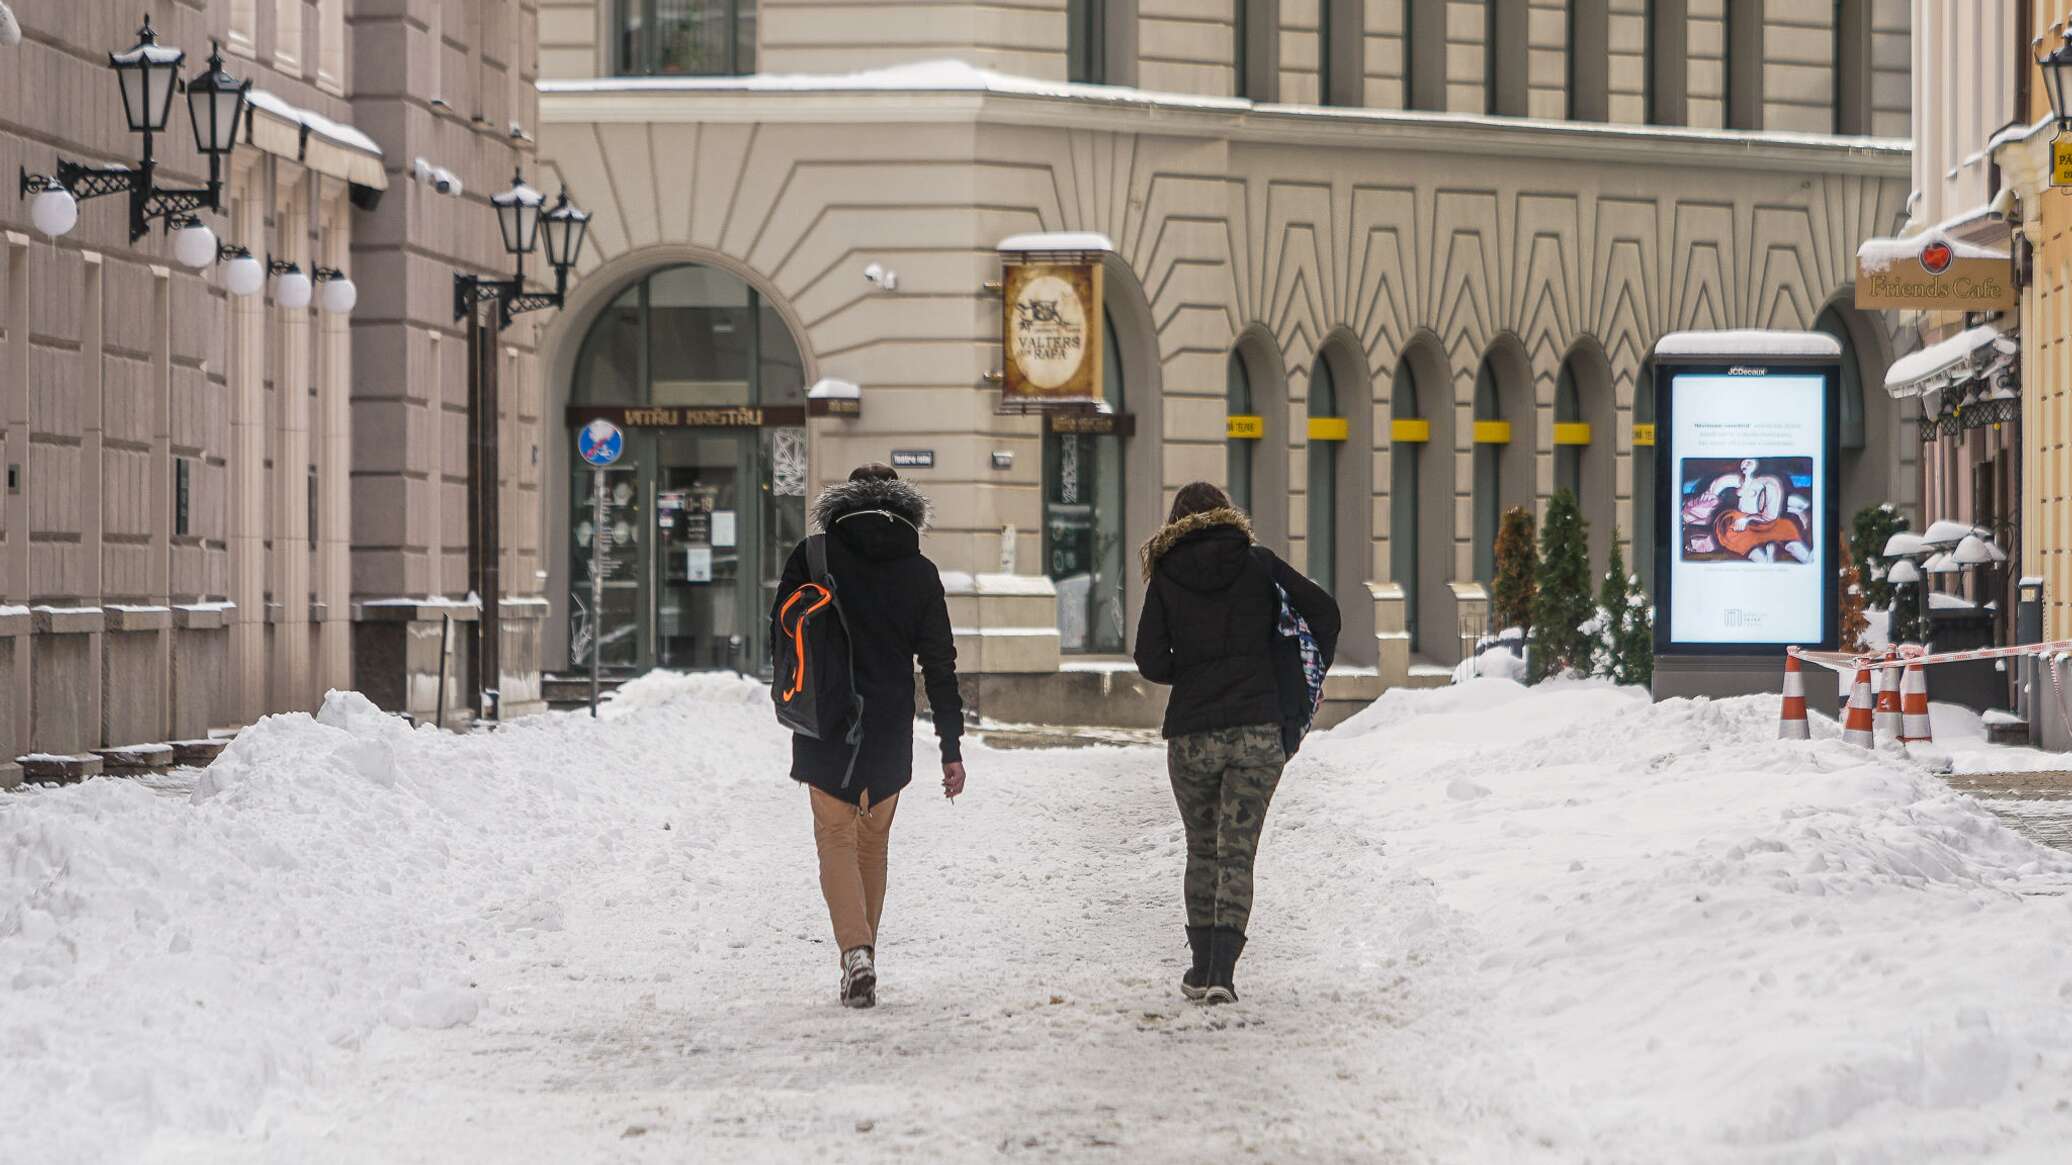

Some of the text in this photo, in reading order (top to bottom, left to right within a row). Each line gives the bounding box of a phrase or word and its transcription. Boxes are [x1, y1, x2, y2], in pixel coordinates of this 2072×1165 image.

[1870, 275, 1949, 298] Friends
[1018, 336, 1080, 350] VALTERS
[1034, 348, 1068, 360] RAPA
[1728, 367, 1766, 376] JCDecaux
